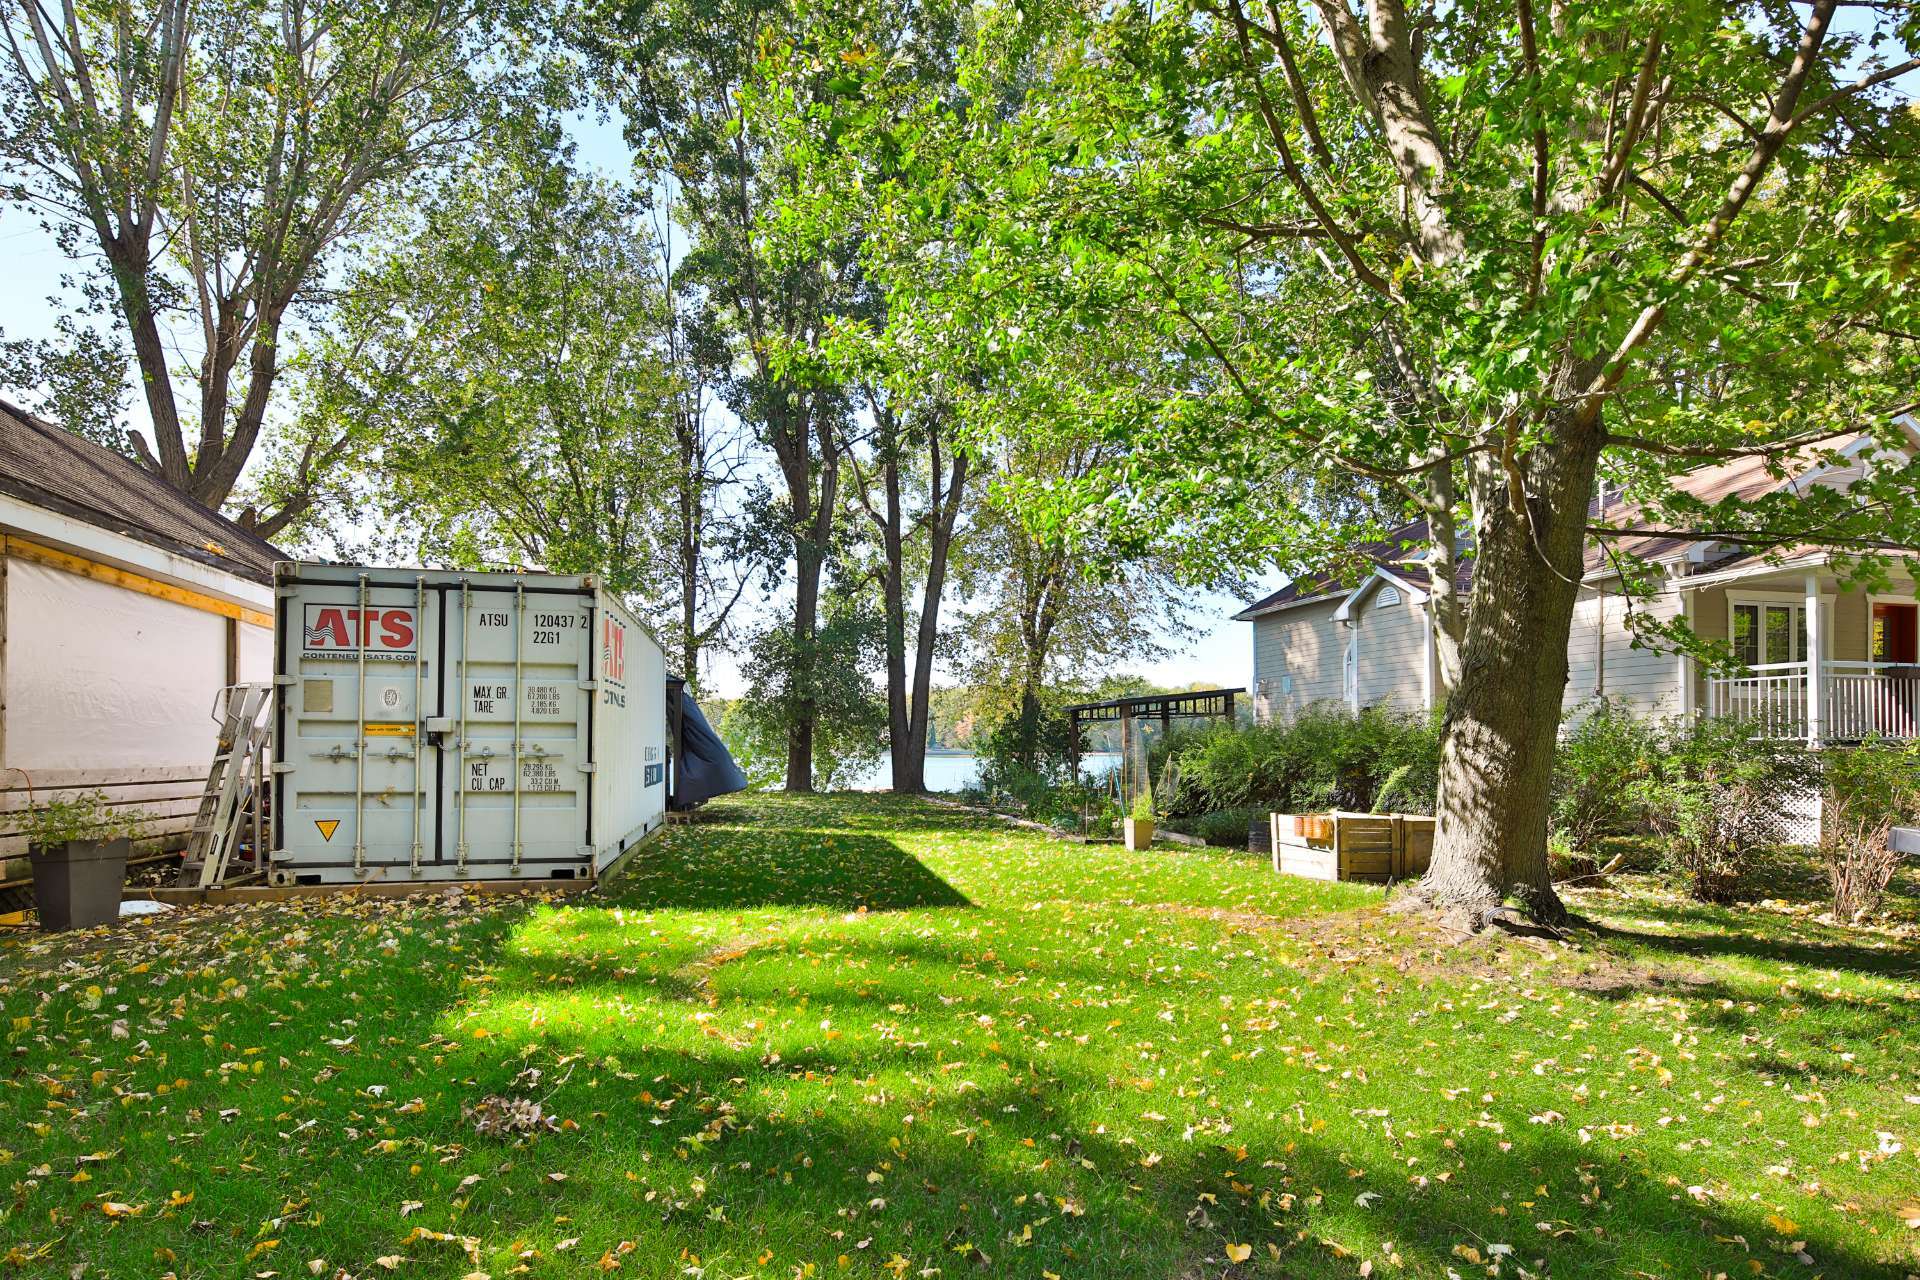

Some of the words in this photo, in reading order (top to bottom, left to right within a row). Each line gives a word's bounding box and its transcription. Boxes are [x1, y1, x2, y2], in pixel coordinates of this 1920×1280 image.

[479, 613, 508, 627] ATSU
[534, 614, 575, 629] 120437
[580, 615, 588, 629] 2
[309, 609, 414, 648] ATS
[533, 631, 561, 645] 22G1
[473, 700, 495, 713] TARE
[471, 764, 488, 776] NET
